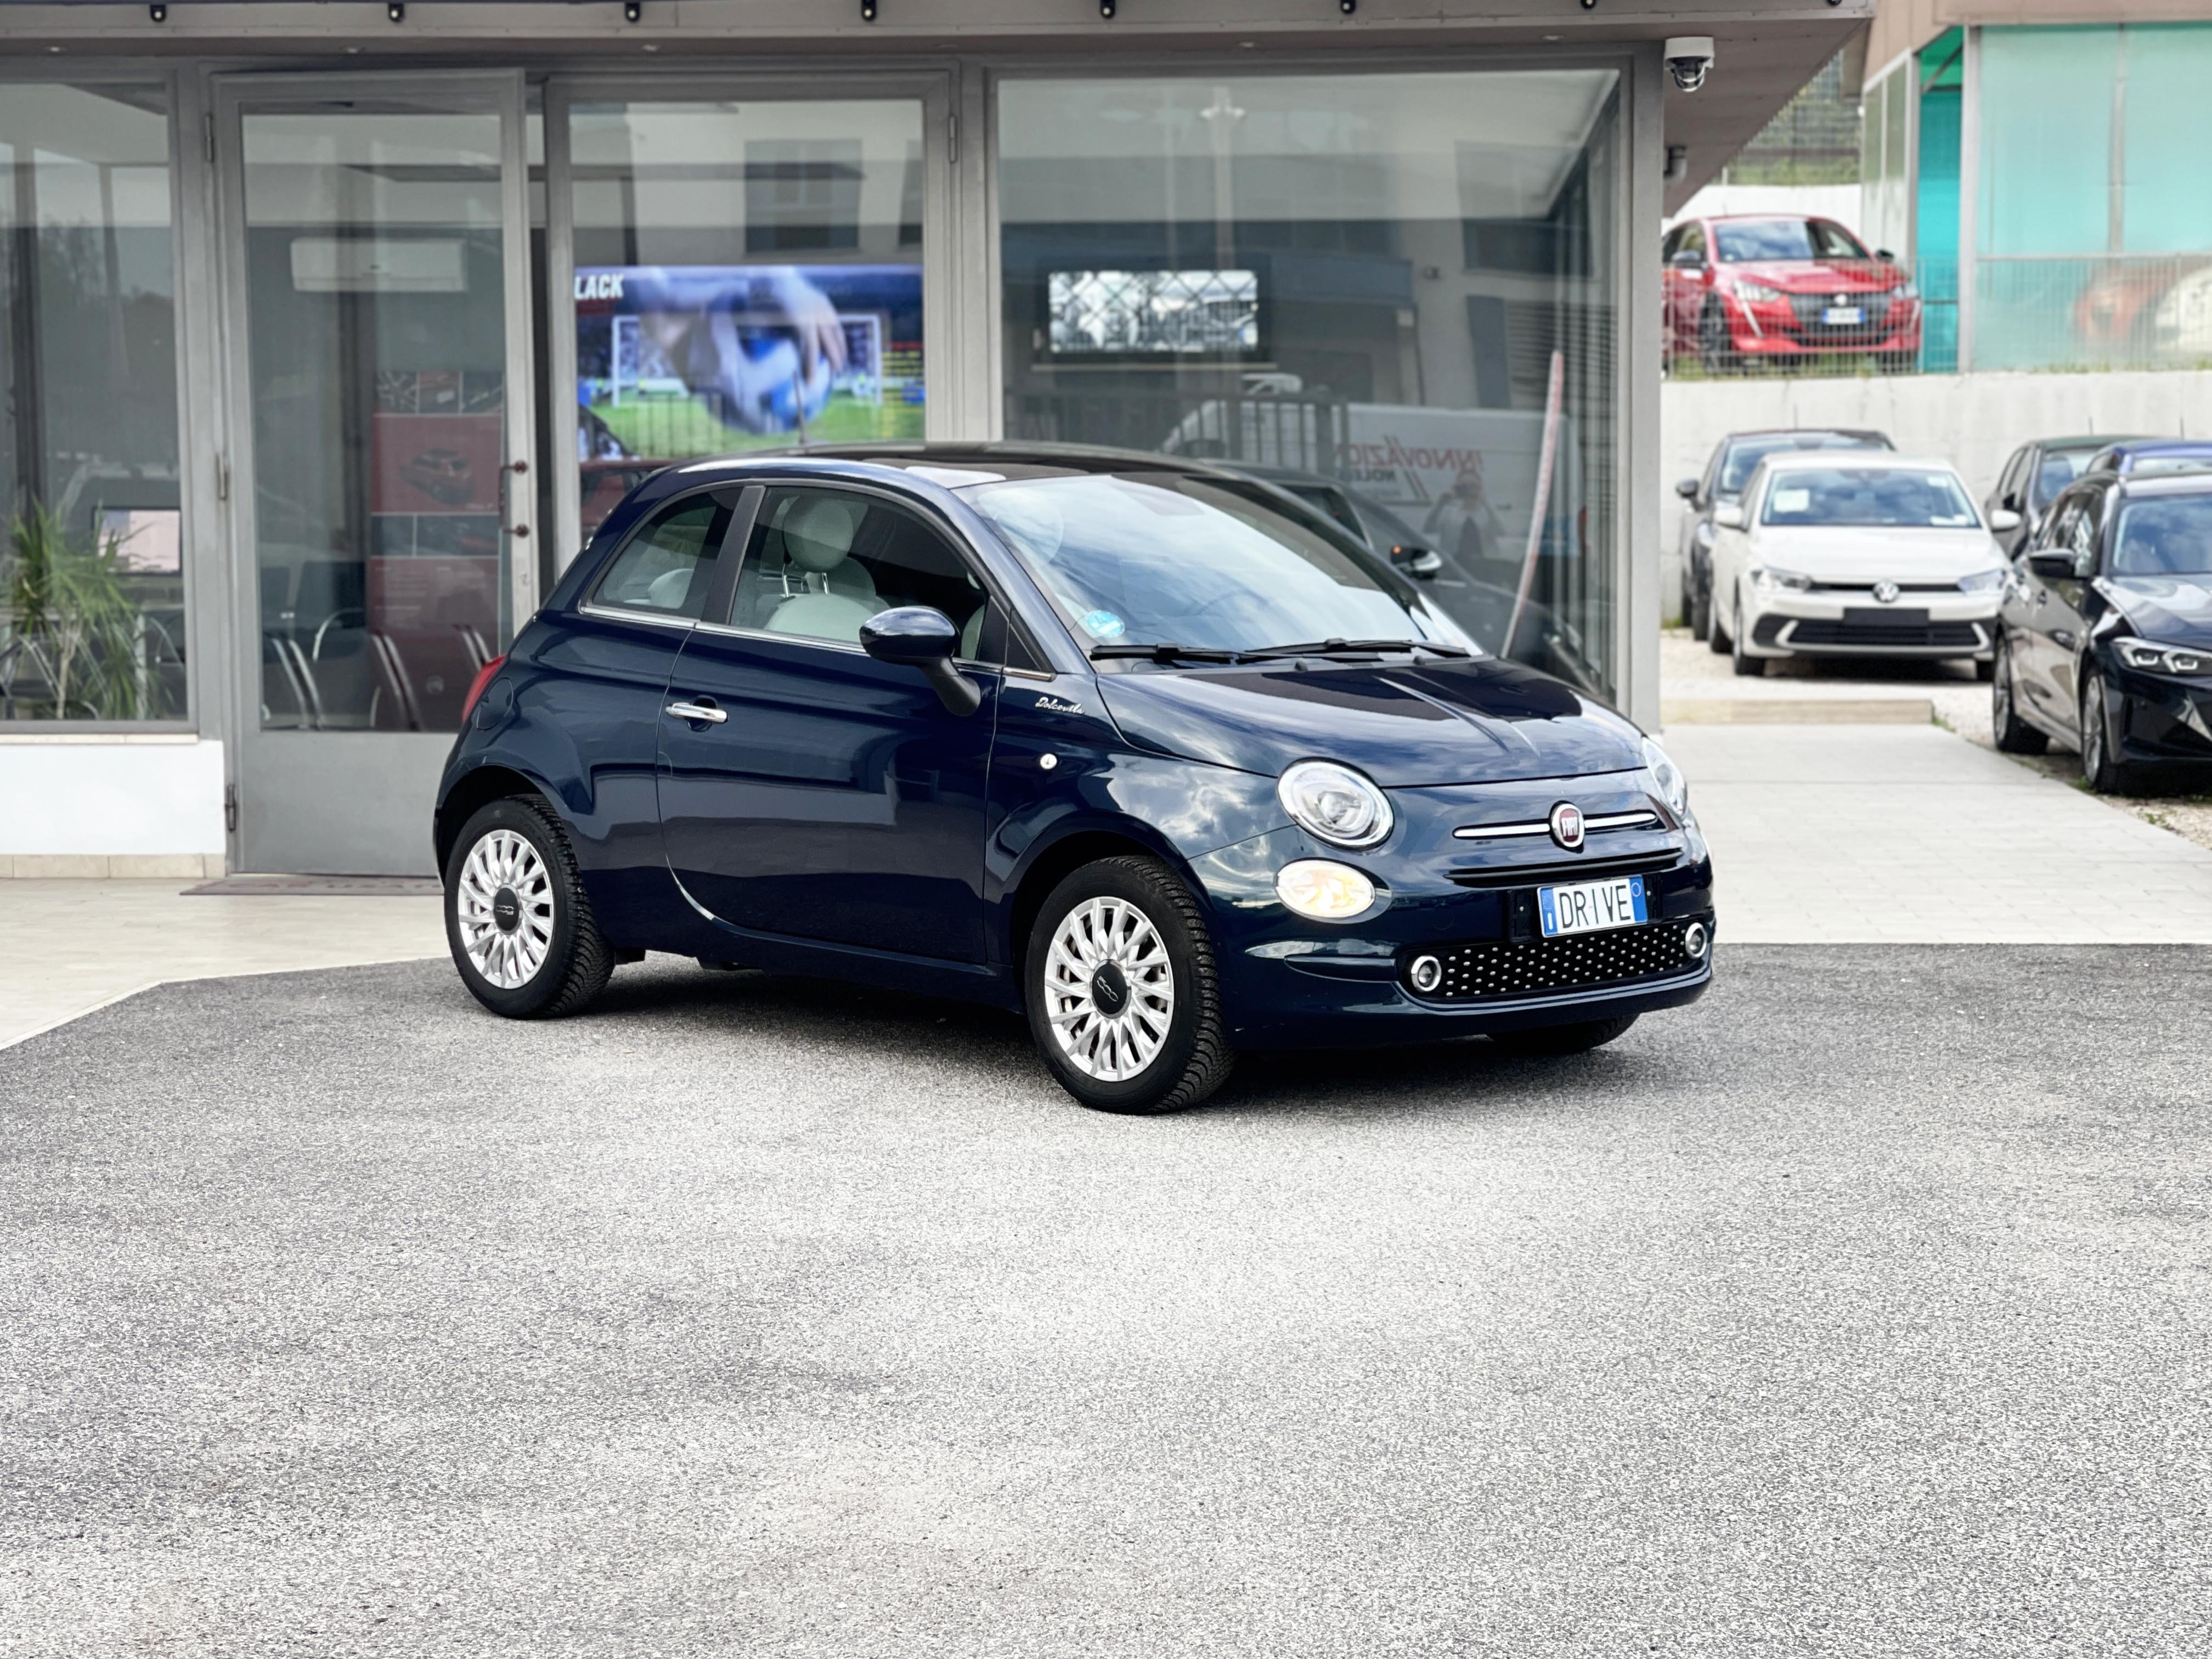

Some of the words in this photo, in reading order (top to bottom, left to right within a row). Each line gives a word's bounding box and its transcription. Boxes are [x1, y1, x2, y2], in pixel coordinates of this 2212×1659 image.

[574, 274, 624, 300] LACK
[1559, 884, 1631, 928] DRIVE
[1097, 975, 1119, 1002] 500
